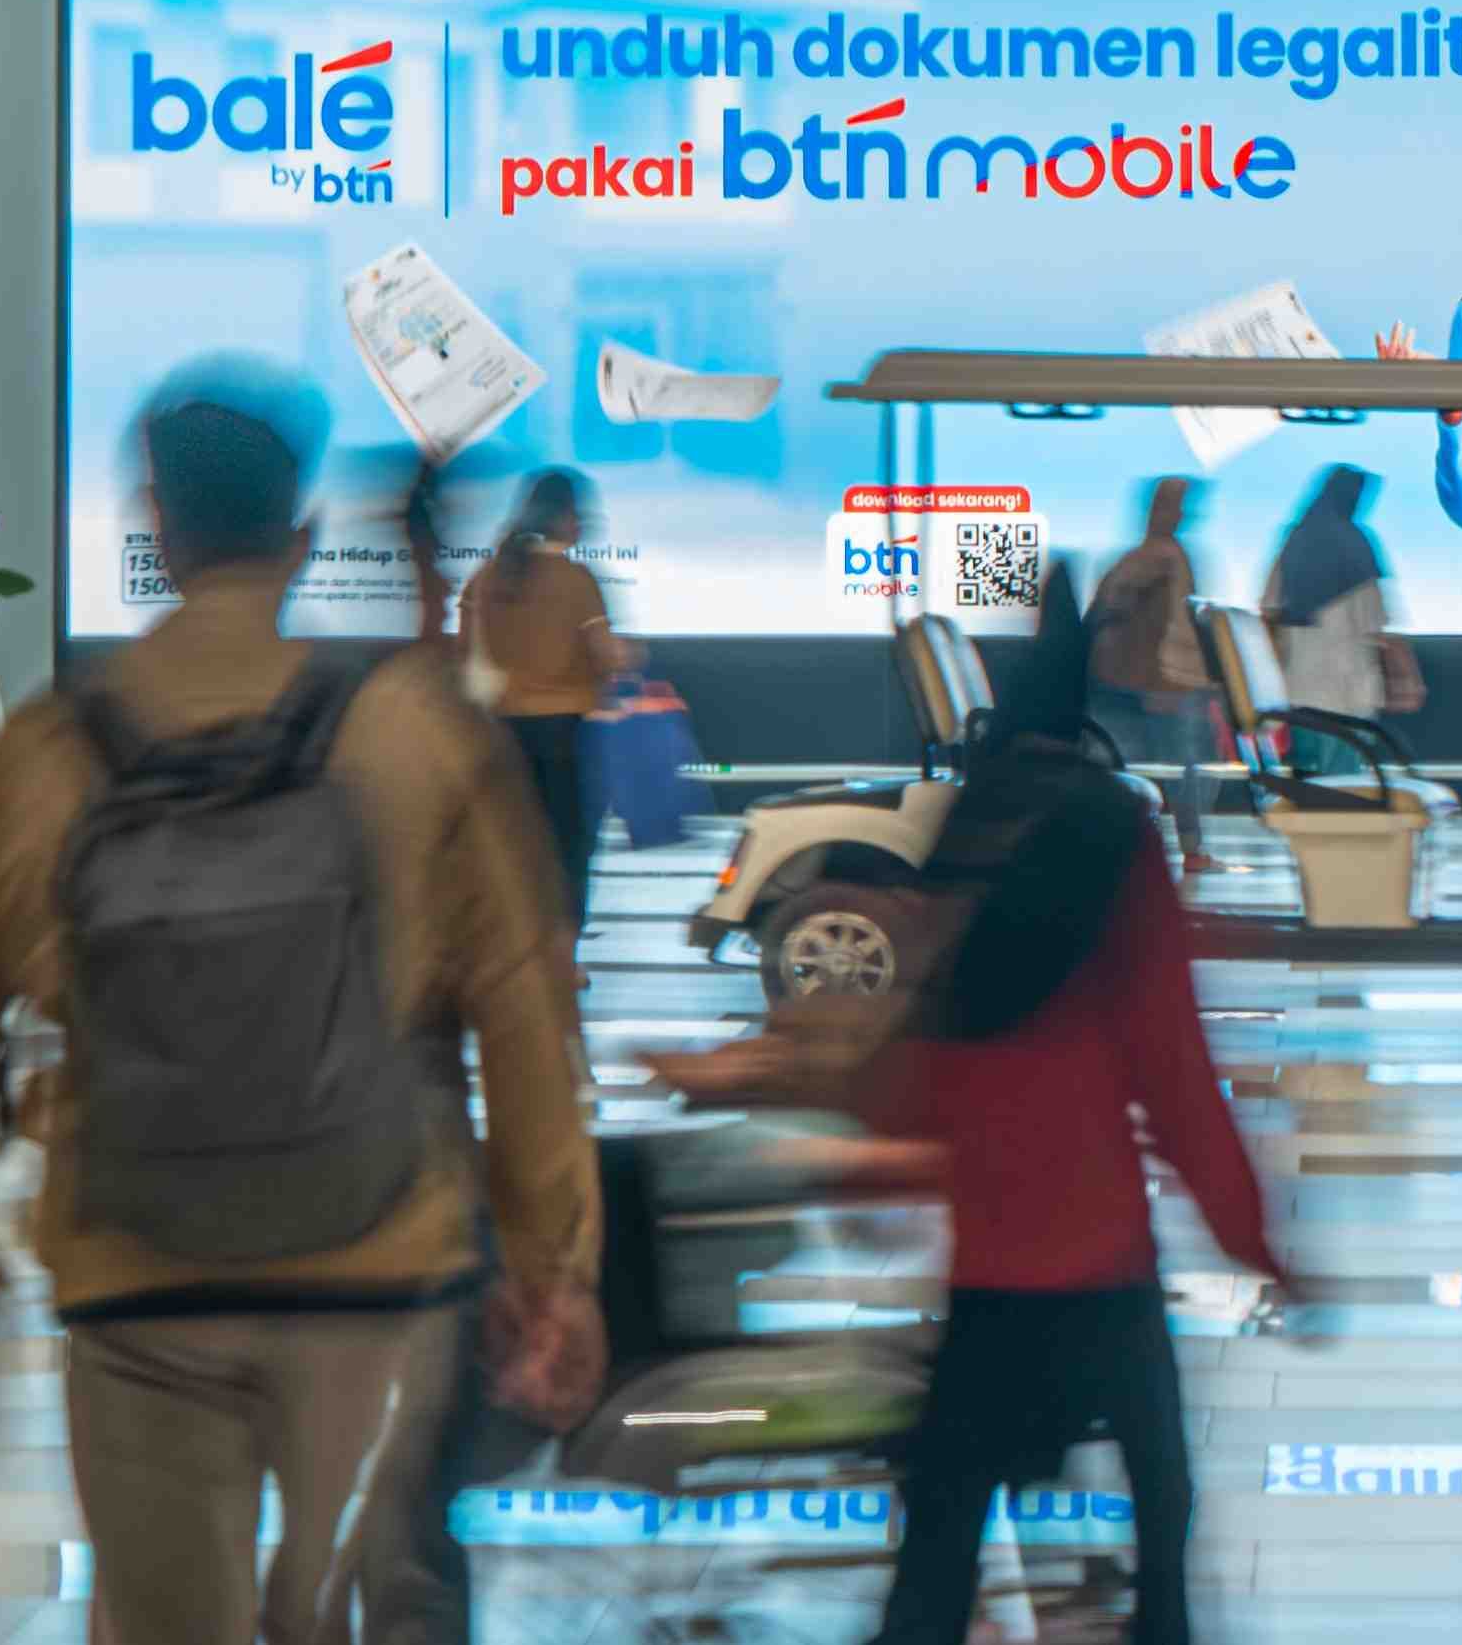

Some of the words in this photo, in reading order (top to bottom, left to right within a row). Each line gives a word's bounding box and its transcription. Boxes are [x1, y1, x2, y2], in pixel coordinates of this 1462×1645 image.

[502, 13, 774, 79] unduh
[792, 13, 1196, 79] dokumen
[272, 163, 306, 192] by
[501, 142, 692, 215] pakai
[926, 123, 1296, 199] mobile
[852, 492, 934, 507] download
[938, 492, 1022, 512] sekarang!
[340, 547, 393, 566] Hidup
[844, 579, 919, 596] mobile
